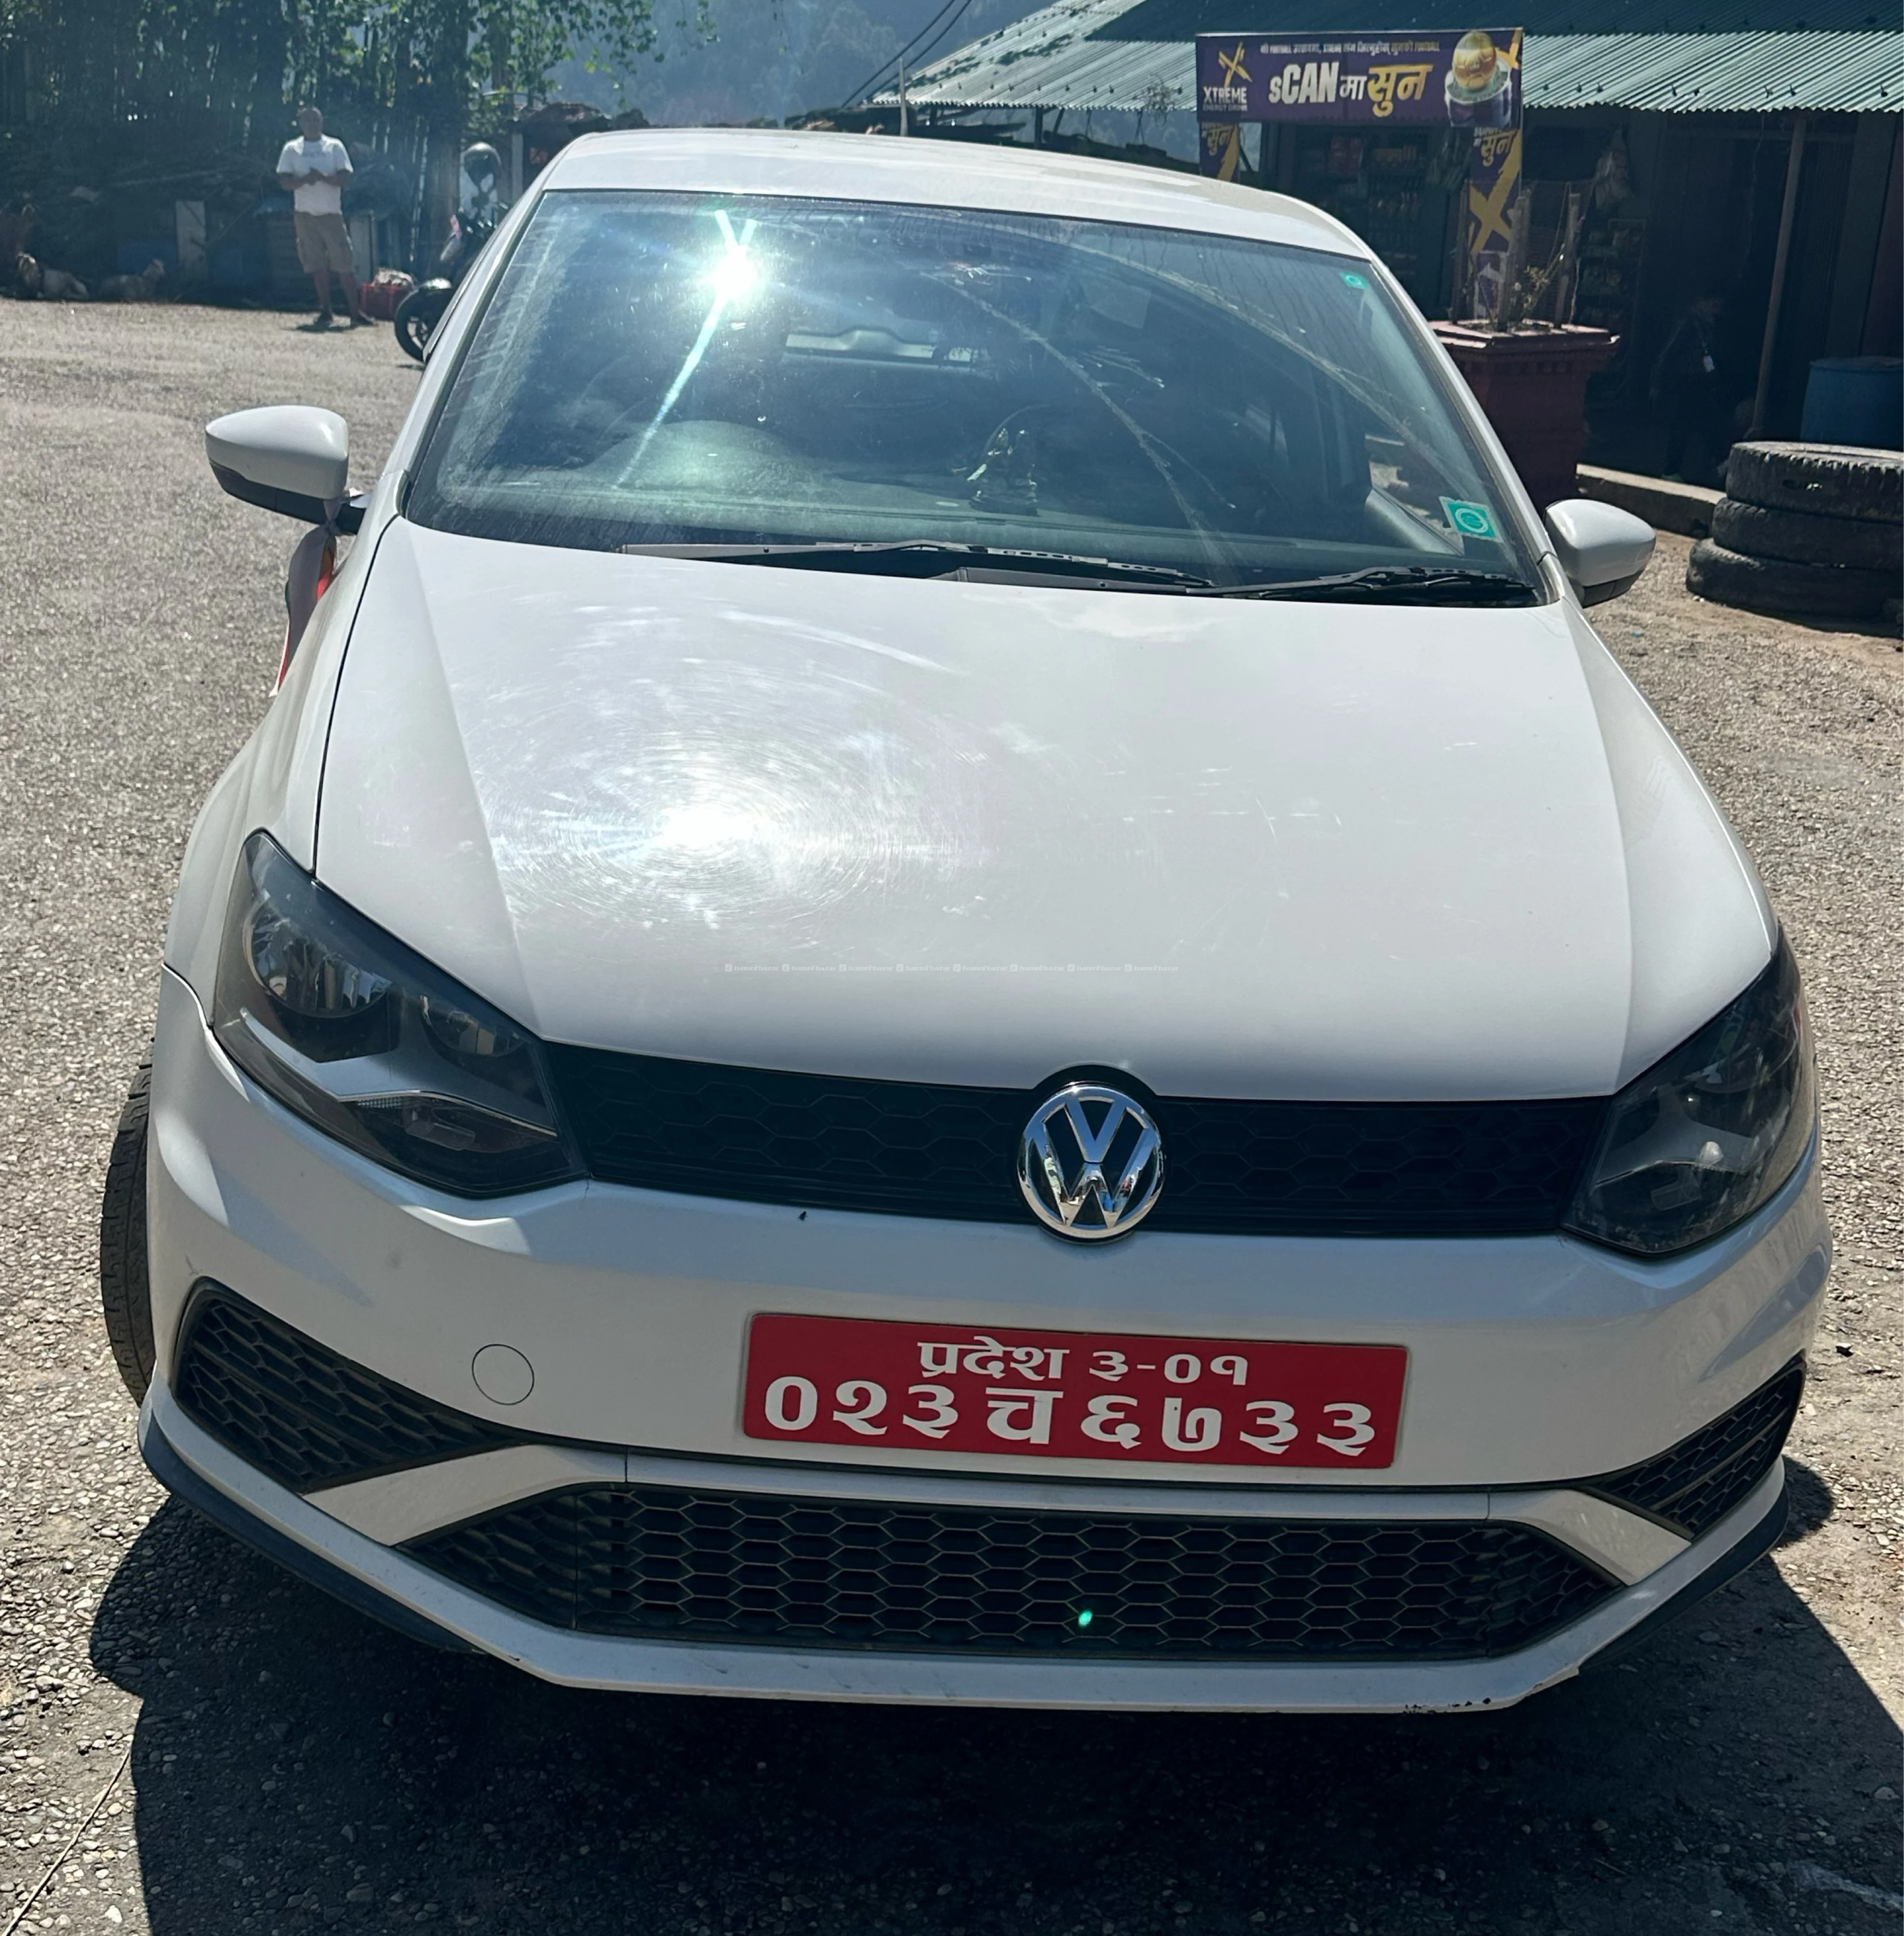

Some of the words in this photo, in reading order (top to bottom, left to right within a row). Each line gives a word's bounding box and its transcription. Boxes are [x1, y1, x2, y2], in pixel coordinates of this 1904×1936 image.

[1203, 86, 1247, 104] XTREME
[1367, 64, 1434, 117] सुन
[917, 1336, 1069, 1380] प्रदेश
[1089, 1351, 1248, 1385] ३-०१
